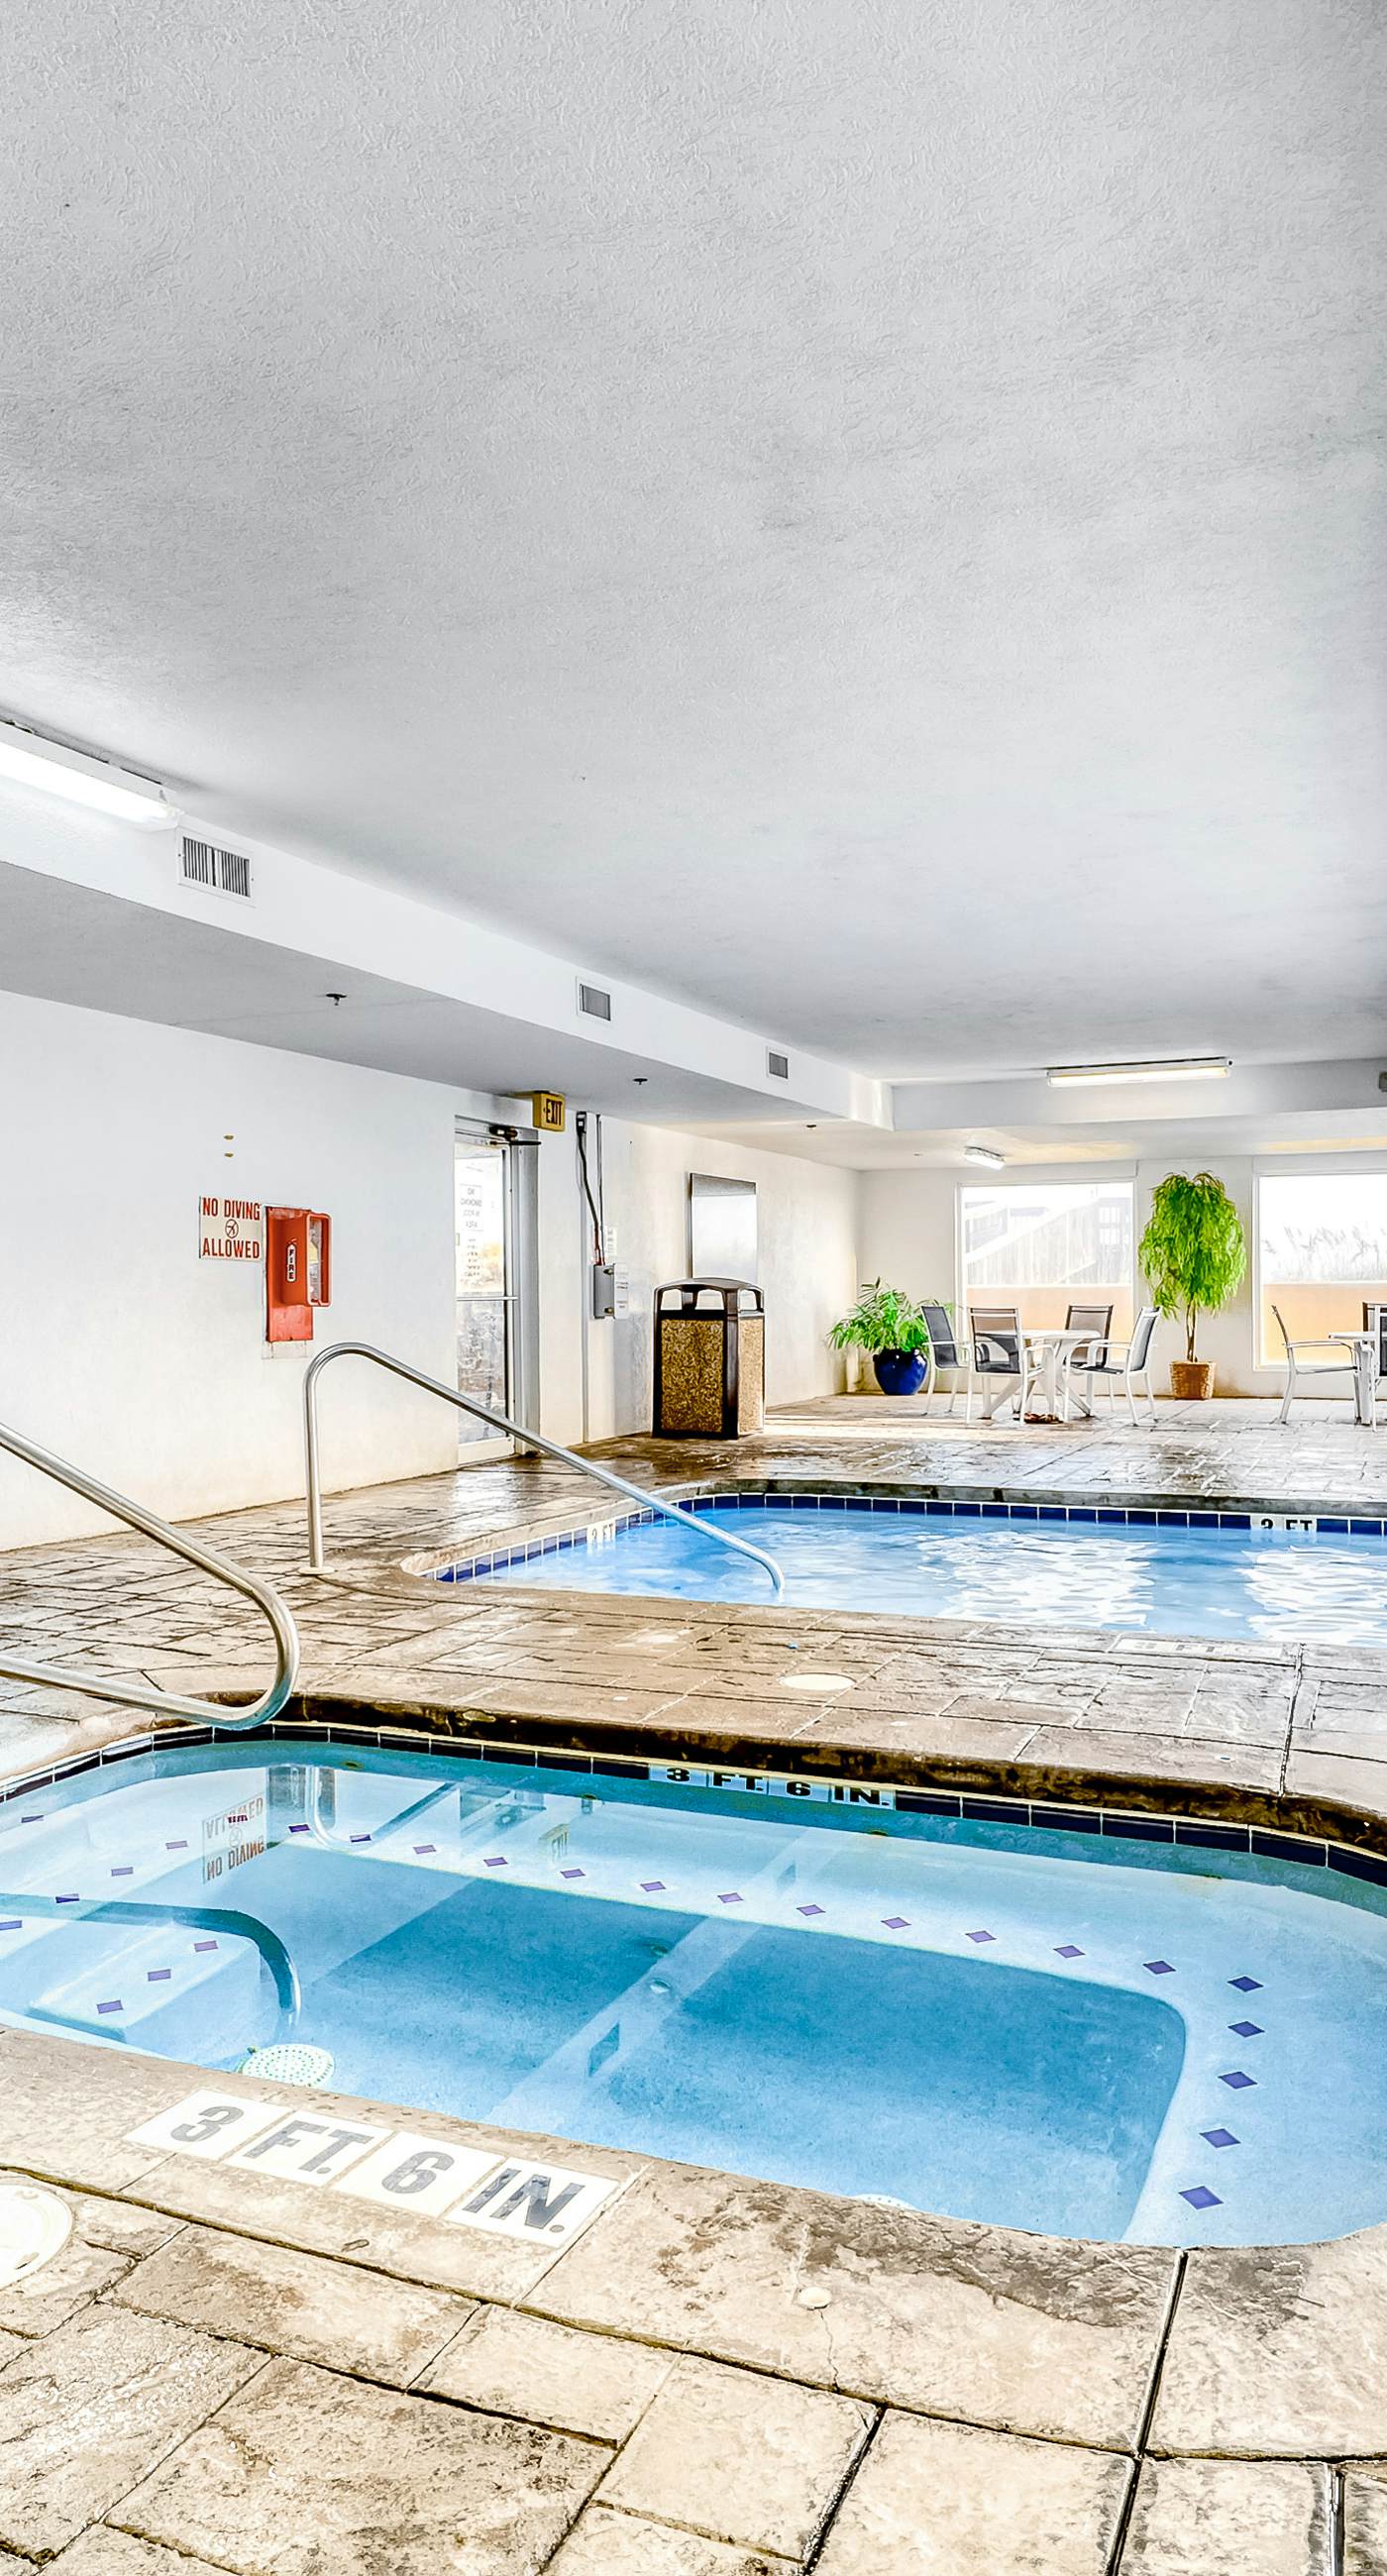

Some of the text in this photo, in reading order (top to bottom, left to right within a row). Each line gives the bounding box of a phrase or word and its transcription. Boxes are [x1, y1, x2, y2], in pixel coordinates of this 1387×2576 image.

[546, 1099, 563, 1126] EXIT
[202, 1197, 261, 1221] NO DIVING
[202, 1237, 261, 1259] ALLOWED
[667, 1768, 890, 1806] 3 FT. 6 IN.
[170, 2105, 586, 2233] 3 FT. 6 IN.
